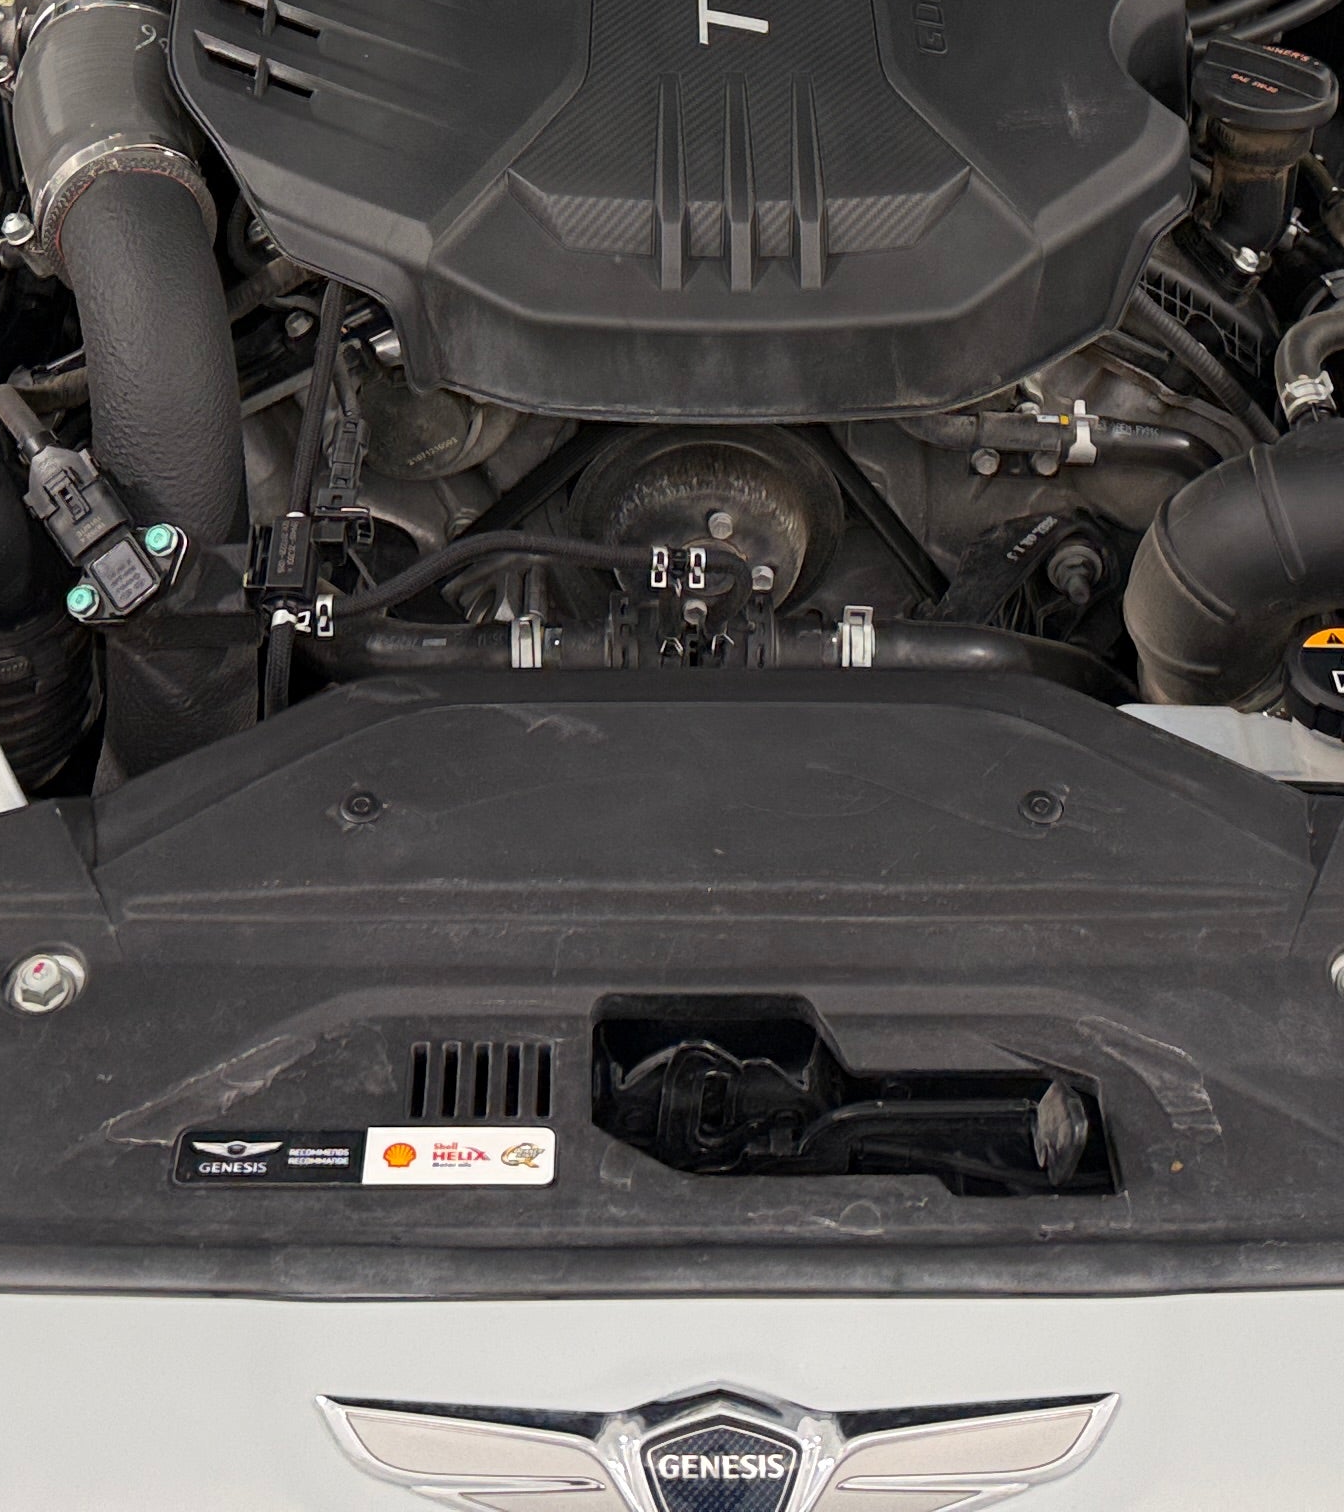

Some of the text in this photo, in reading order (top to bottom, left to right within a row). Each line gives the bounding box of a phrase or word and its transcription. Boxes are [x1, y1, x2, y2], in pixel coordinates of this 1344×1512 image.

[433, 1141, 459, 1151] Shell
[432, 1149, 490, 1162] HELIX
[198, 1161, 269, 1175] GENESIS
[657, 1453, 786, 1481] GENESIS
